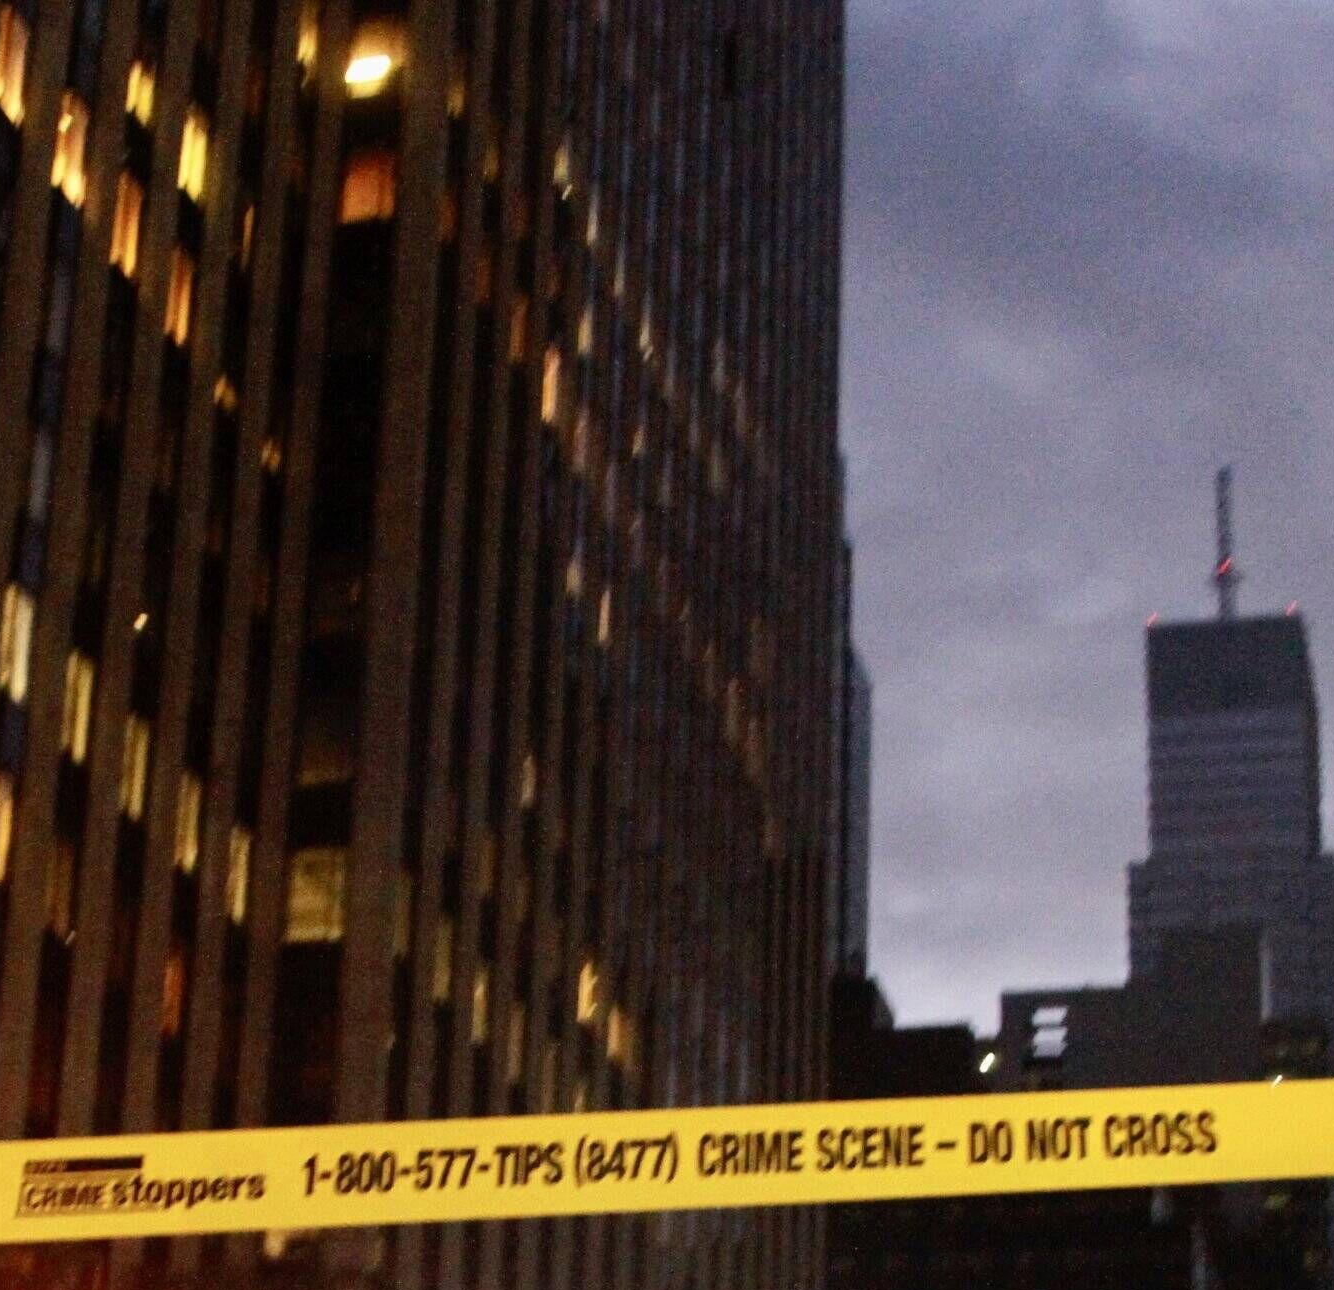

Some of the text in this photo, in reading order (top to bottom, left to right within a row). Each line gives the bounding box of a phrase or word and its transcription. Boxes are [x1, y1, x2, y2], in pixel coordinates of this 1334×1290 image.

[303, 1142, 566, 1197] 1-800-577-TIPS
[574, 1130, 680, 1189] (8477)
[696, 1129, 804, 1178] CRIME
[815, 1123, 926, 1173] SCENE
[968, 1120, 1015, 1165] DO
[1026, 1116, 1091, 1163] NOT
[1104, 1110, 1218, 1159] CROSS
